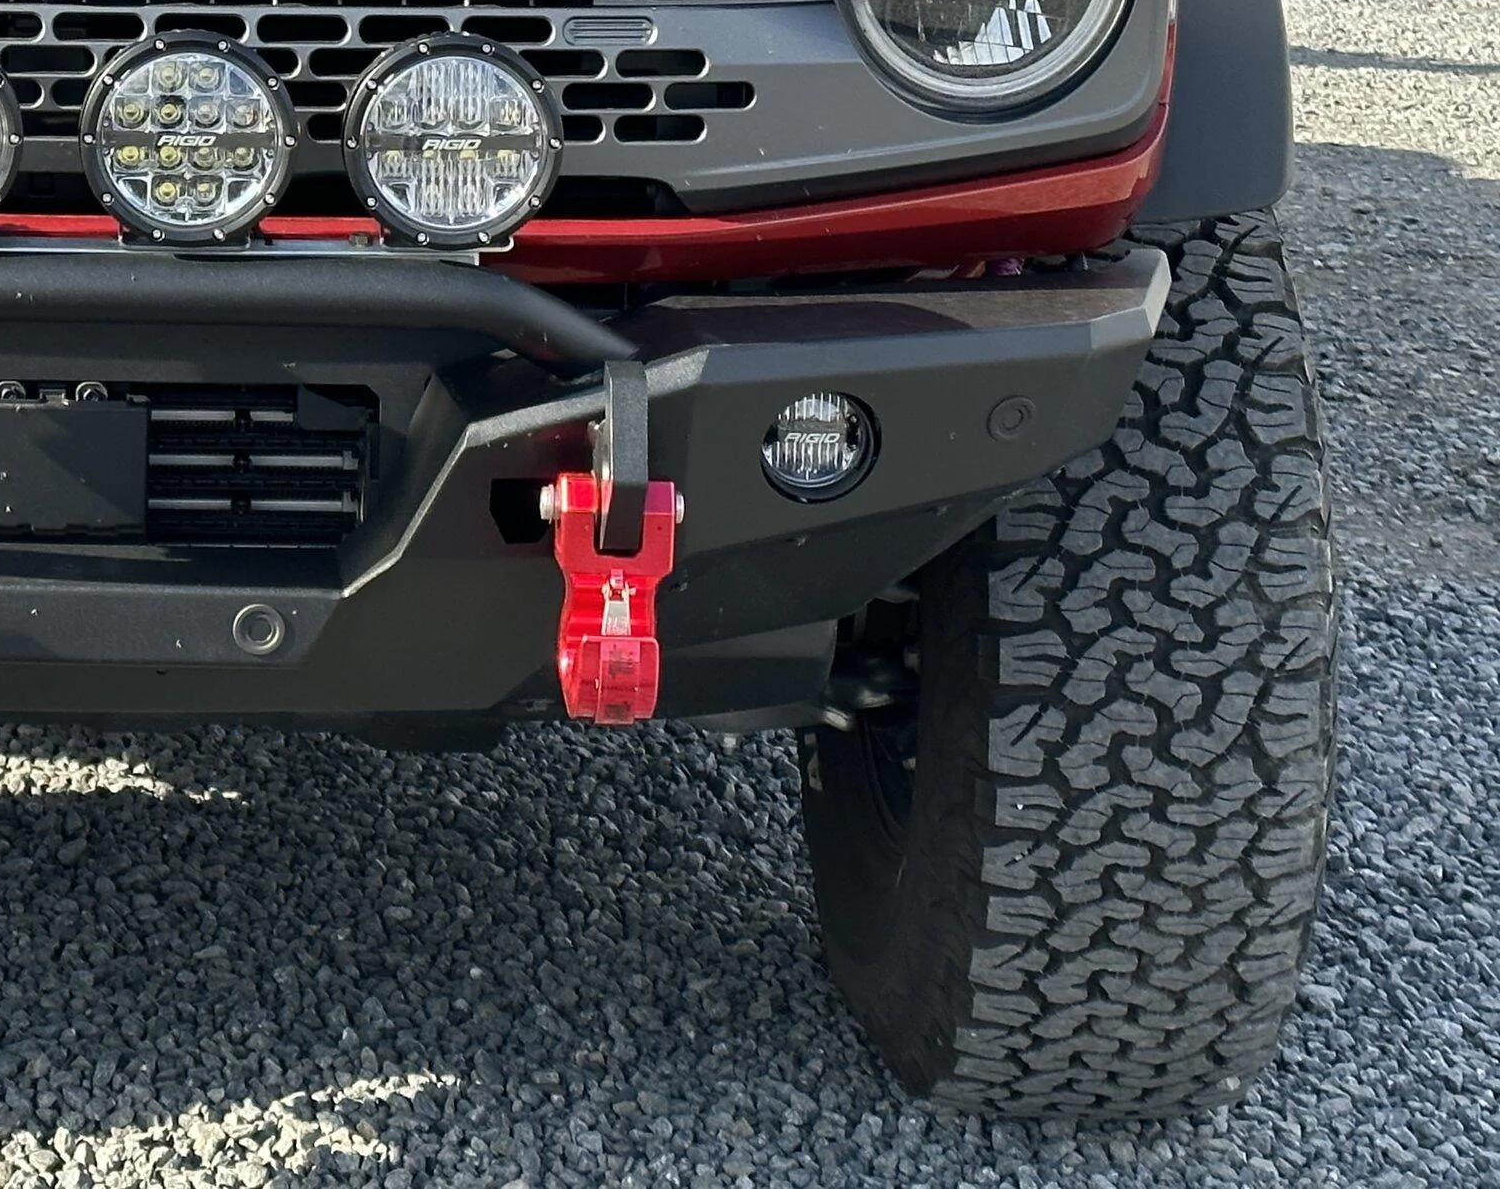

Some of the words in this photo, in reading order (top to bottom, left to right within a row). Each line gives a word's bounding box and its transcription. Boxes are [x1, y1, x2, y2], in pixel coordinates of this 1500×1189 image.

[156, 134, 217, 147] RIGID
[421, 138, 482, 151] RIGID
[784, 432, 841, 444] RIGID
